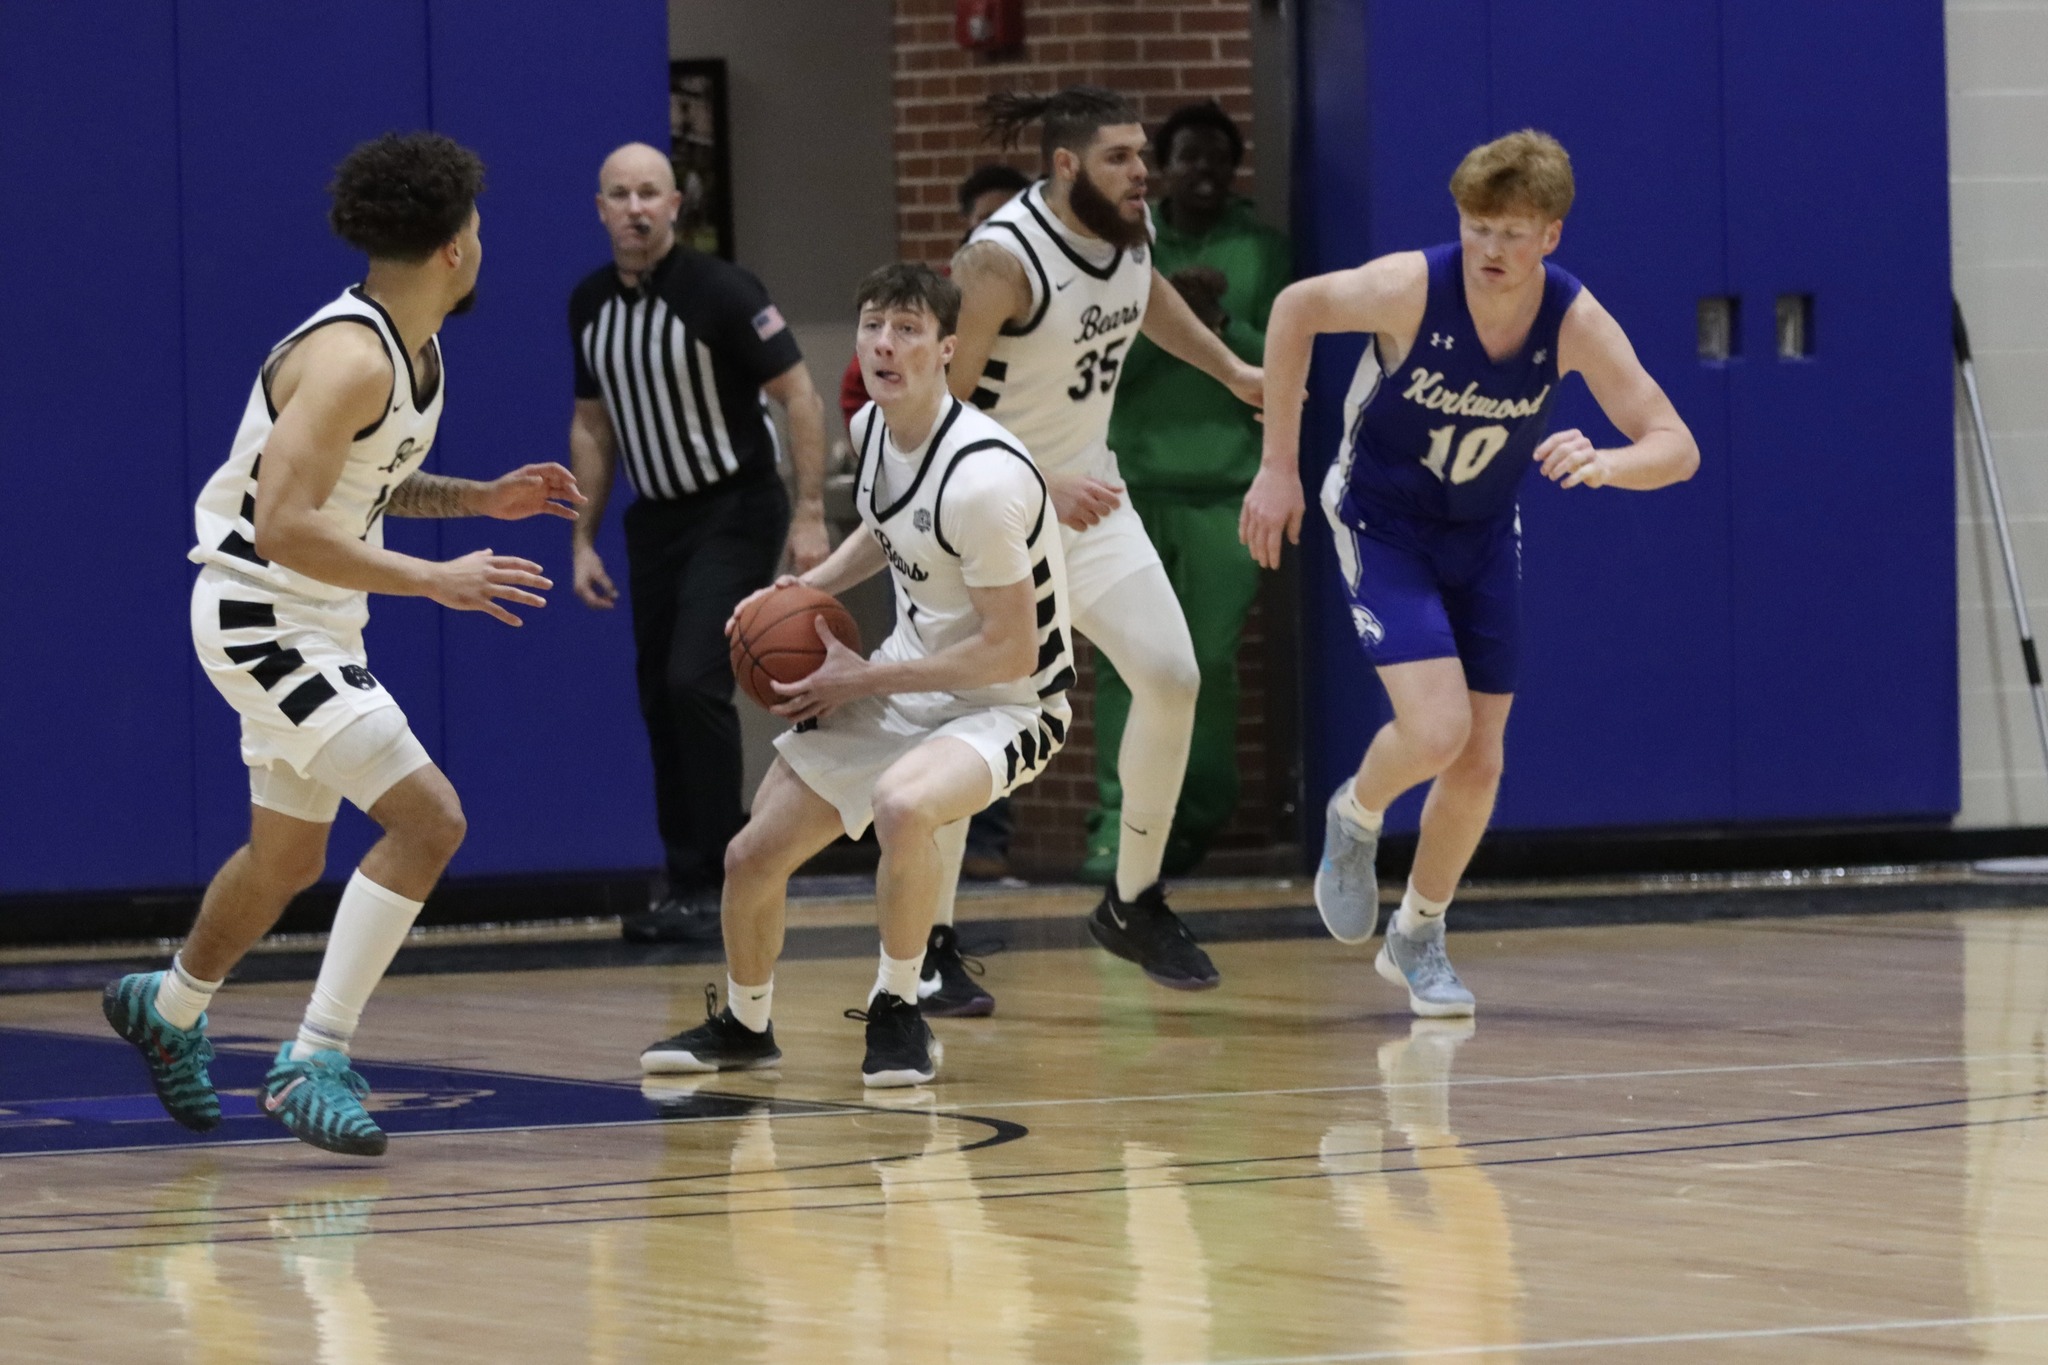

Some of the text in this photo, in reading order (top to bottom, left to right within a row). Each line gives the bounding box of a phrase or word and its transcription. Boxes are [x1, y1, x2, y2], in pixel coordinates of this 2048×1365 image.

[1074, 301, 1140, 344] Bears
[1068, 337, 1127, 401] 35
[1402, 367, 1550, 419] Kirkwood
[1419, 424, 1510, 486] 10
[874, 529, 929, 582] Bears
